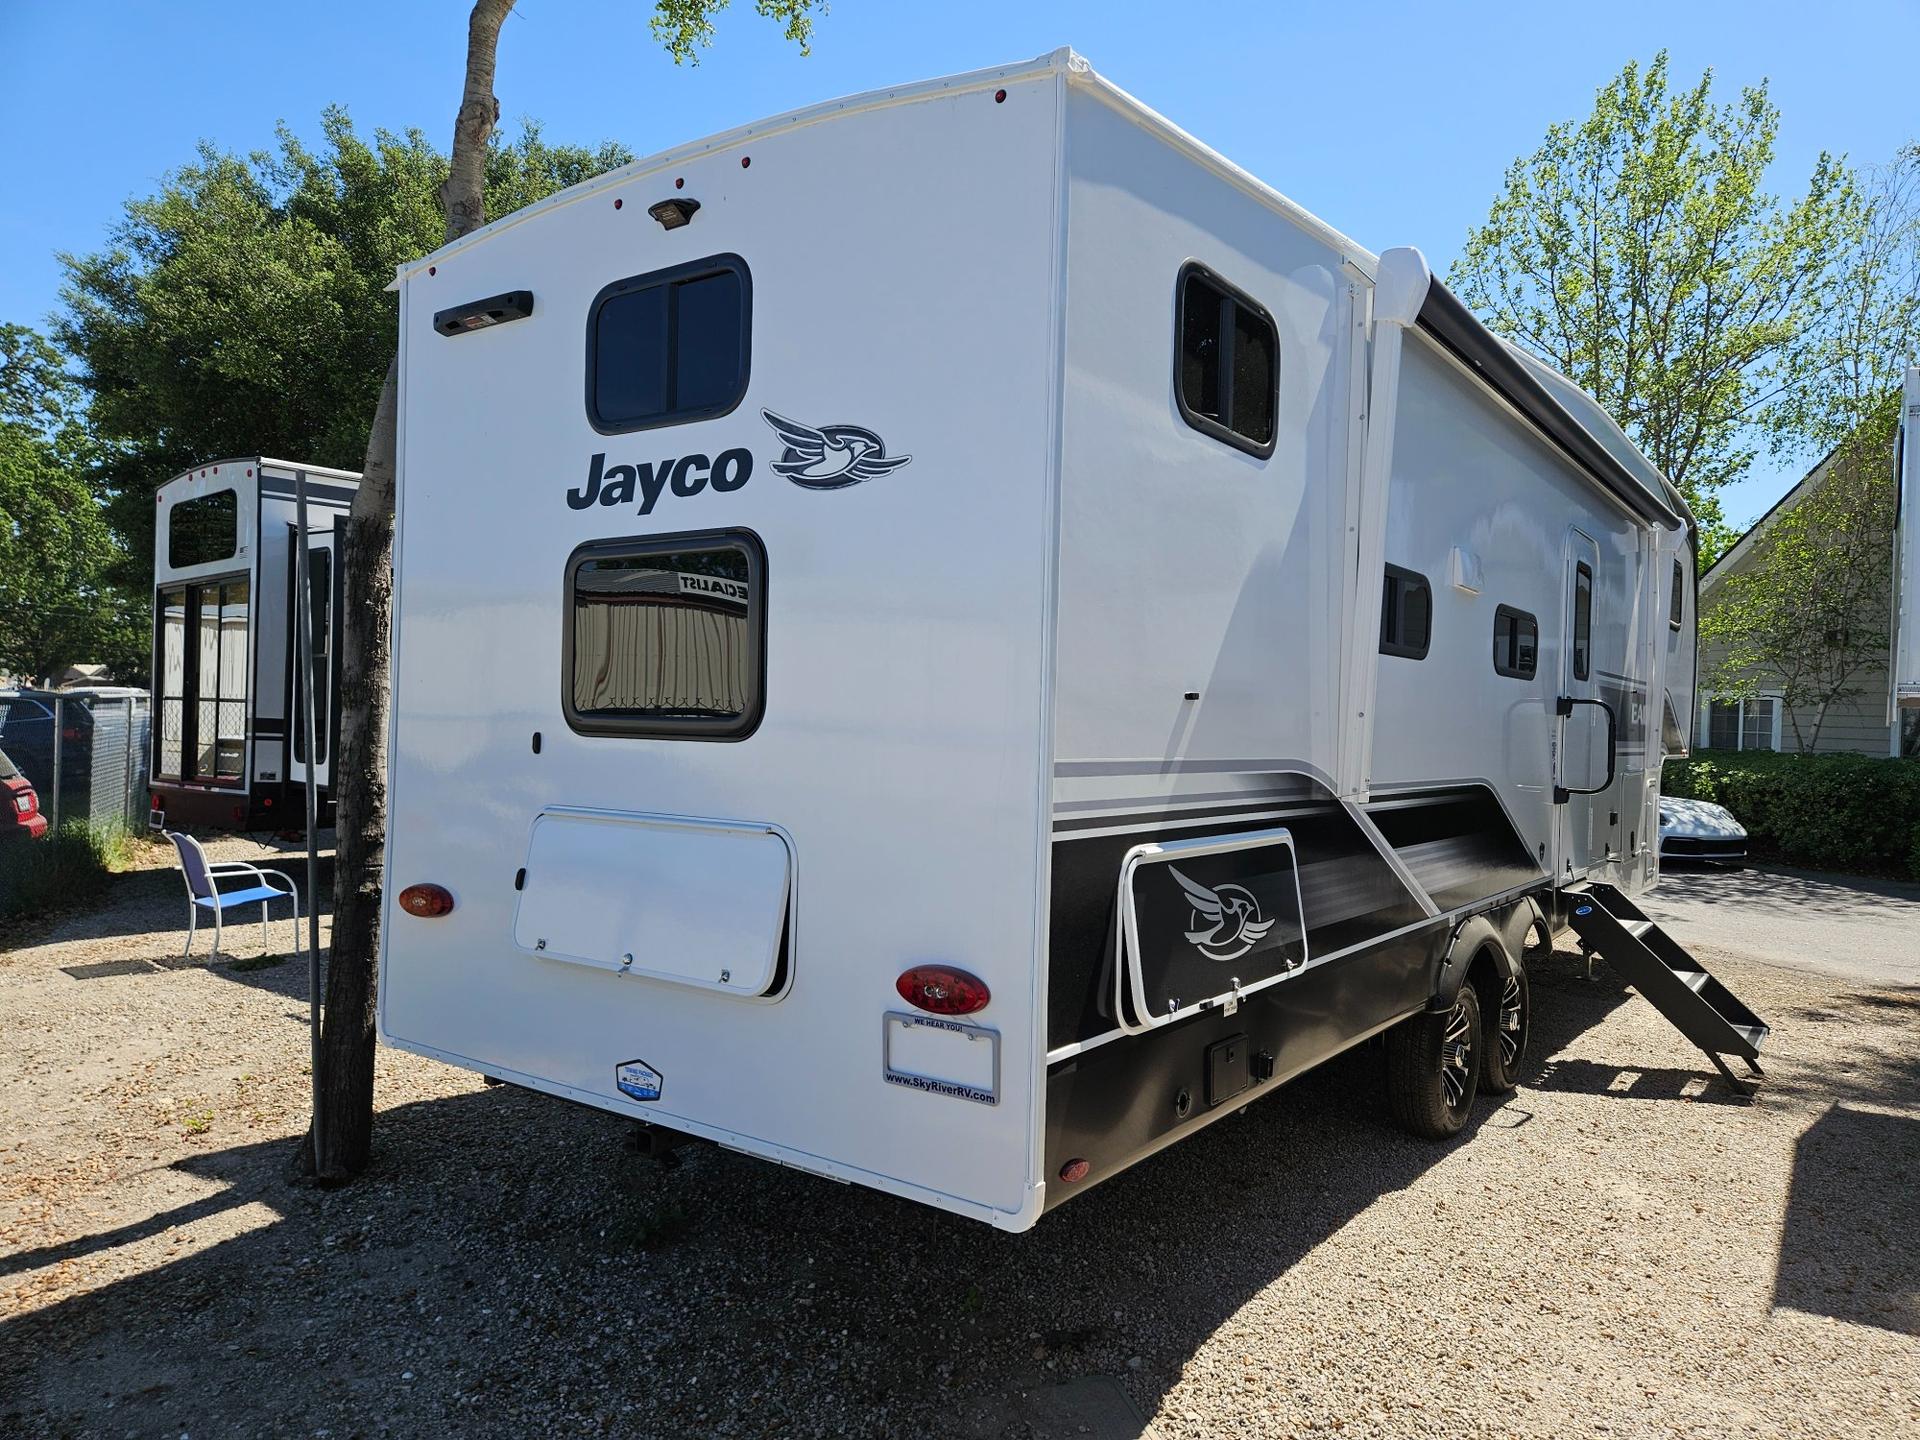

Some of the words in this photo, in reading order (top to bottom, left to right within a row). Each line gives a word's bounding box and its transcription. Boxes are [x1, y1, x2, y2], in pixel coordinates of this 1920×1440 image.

[567, 448, 753, 515] Jayco
[914, 1018, 923, 1026] WE
[926, 1019, 945, 1030] HEAR
[886, 1072, 996, 1104] www.SkyRiverRV.com
